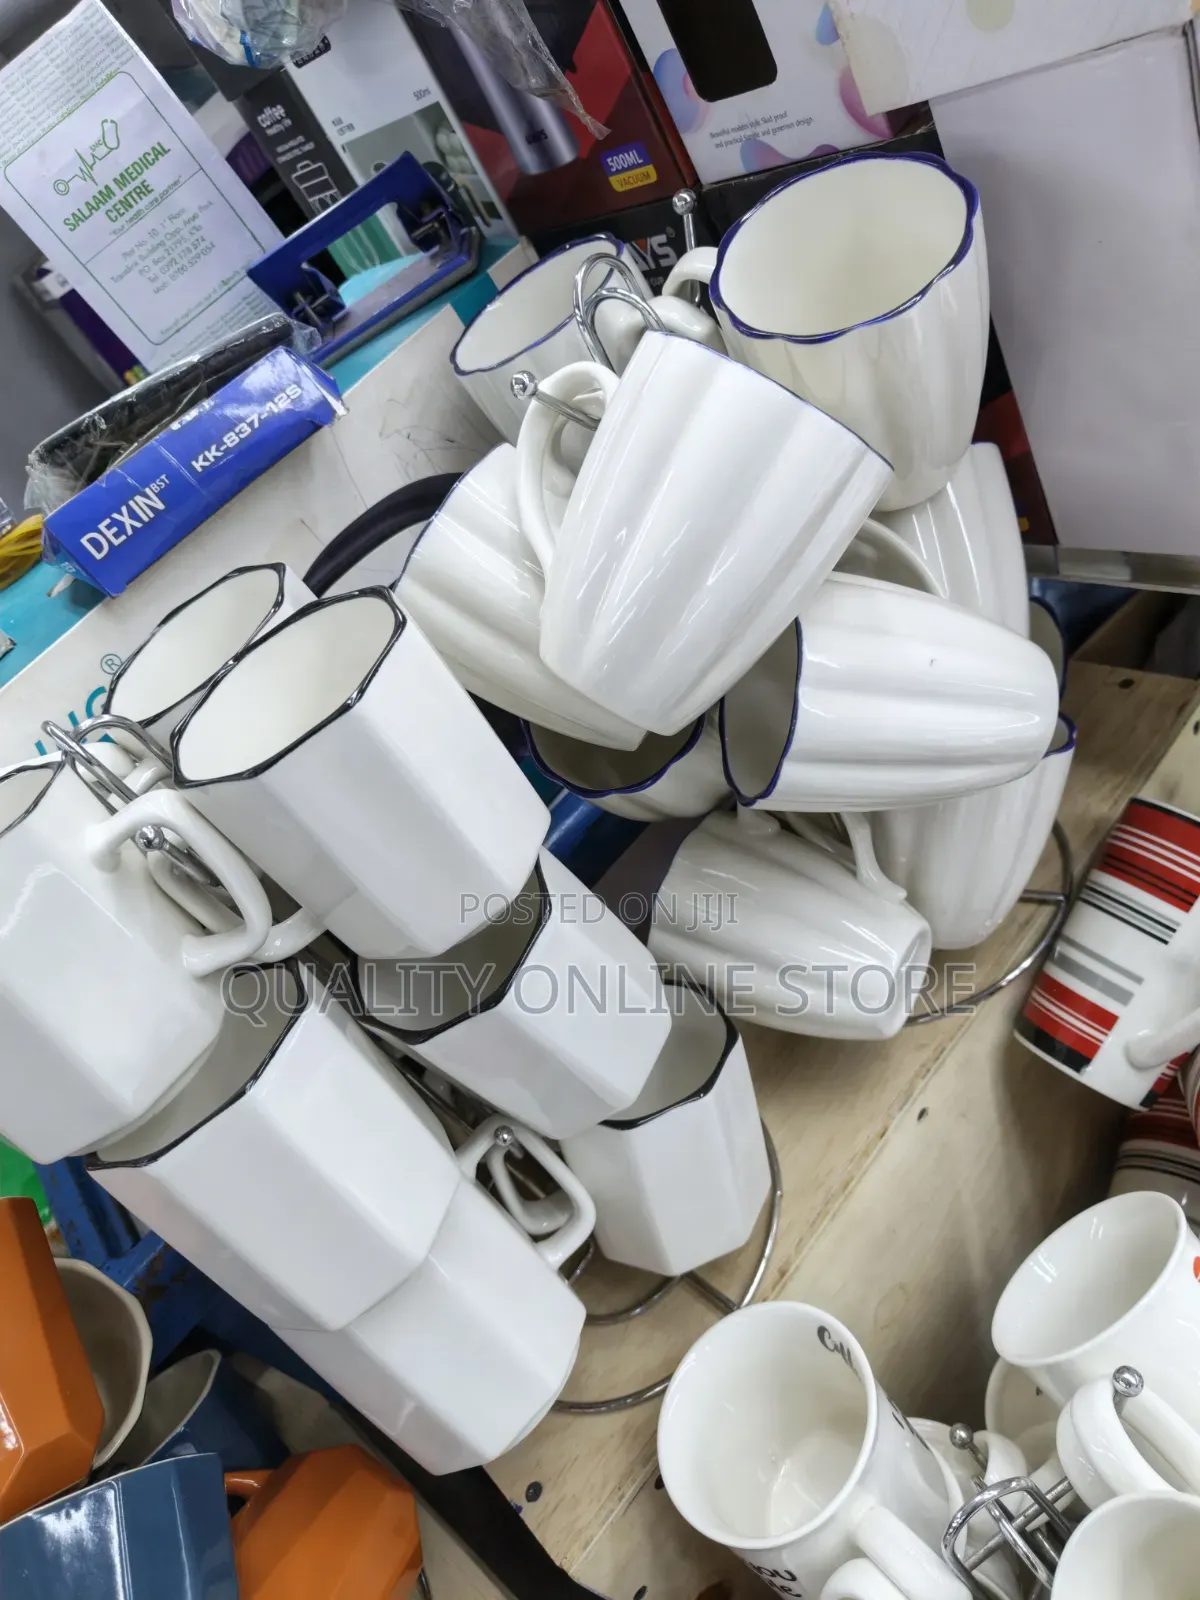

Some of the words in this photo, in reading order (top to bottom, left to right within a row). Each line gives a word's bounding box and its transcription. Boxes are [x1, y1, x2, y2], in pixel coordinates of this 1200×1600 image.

[257, 104, 286, 128] coffee
[606, 149, 644, 172] 500ML
[63, 184, 117, 232] SALAAM
[112, 141, 171, 191] MEDICAL
[616, 170, 652, 189] VACUUM
[105, 179, 154, 223] CENTRE
[125, 209, 145, 225] health
[144, 196, 159, 211] care
[190, 383, 302, 473] KK-837-12S
[80, 487, 166, 561] DEXIN
[151, 474, 170, 494] BST
